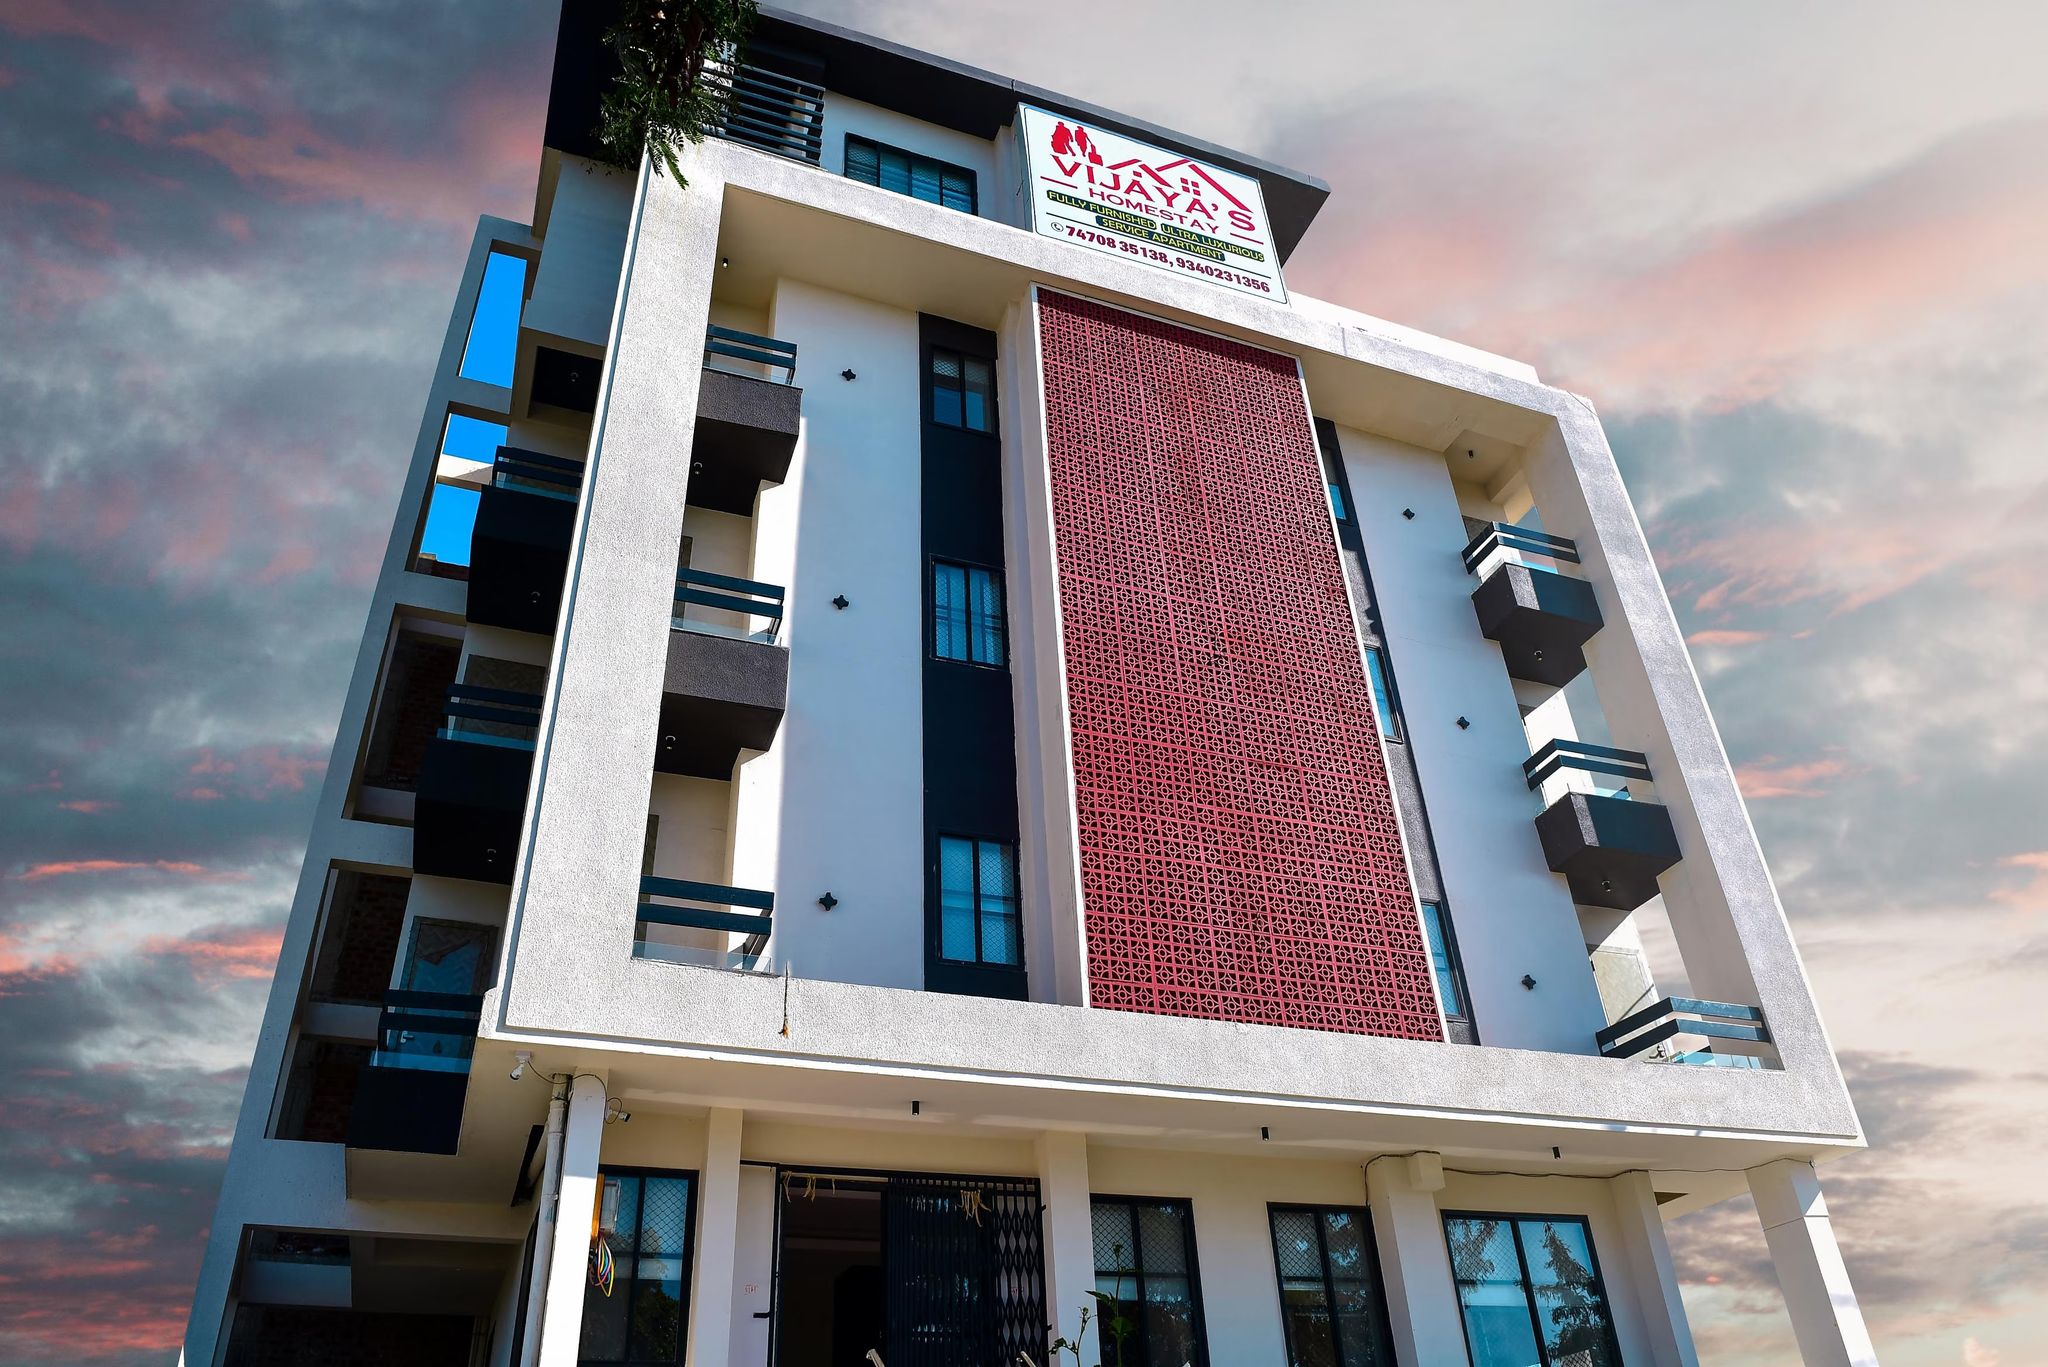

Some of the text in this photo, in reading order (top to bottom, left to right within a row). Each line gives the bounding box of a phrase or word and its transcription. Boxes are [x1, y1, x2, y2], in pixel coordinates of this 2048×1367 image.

[1049, 191, 1264, 261] FULLY FURNISHED ULTRA LUXURIOUS
[1050, 154, 1255, 231] VIJAYA'S
[1089, 187, 1219, 234] HOMESTAY
[1066, 225, 1116, 248] 74708
[1176, 257, 1270, 293] 9340231356
[1102, 218, 1222, 259] SERVICE APARTMENT
